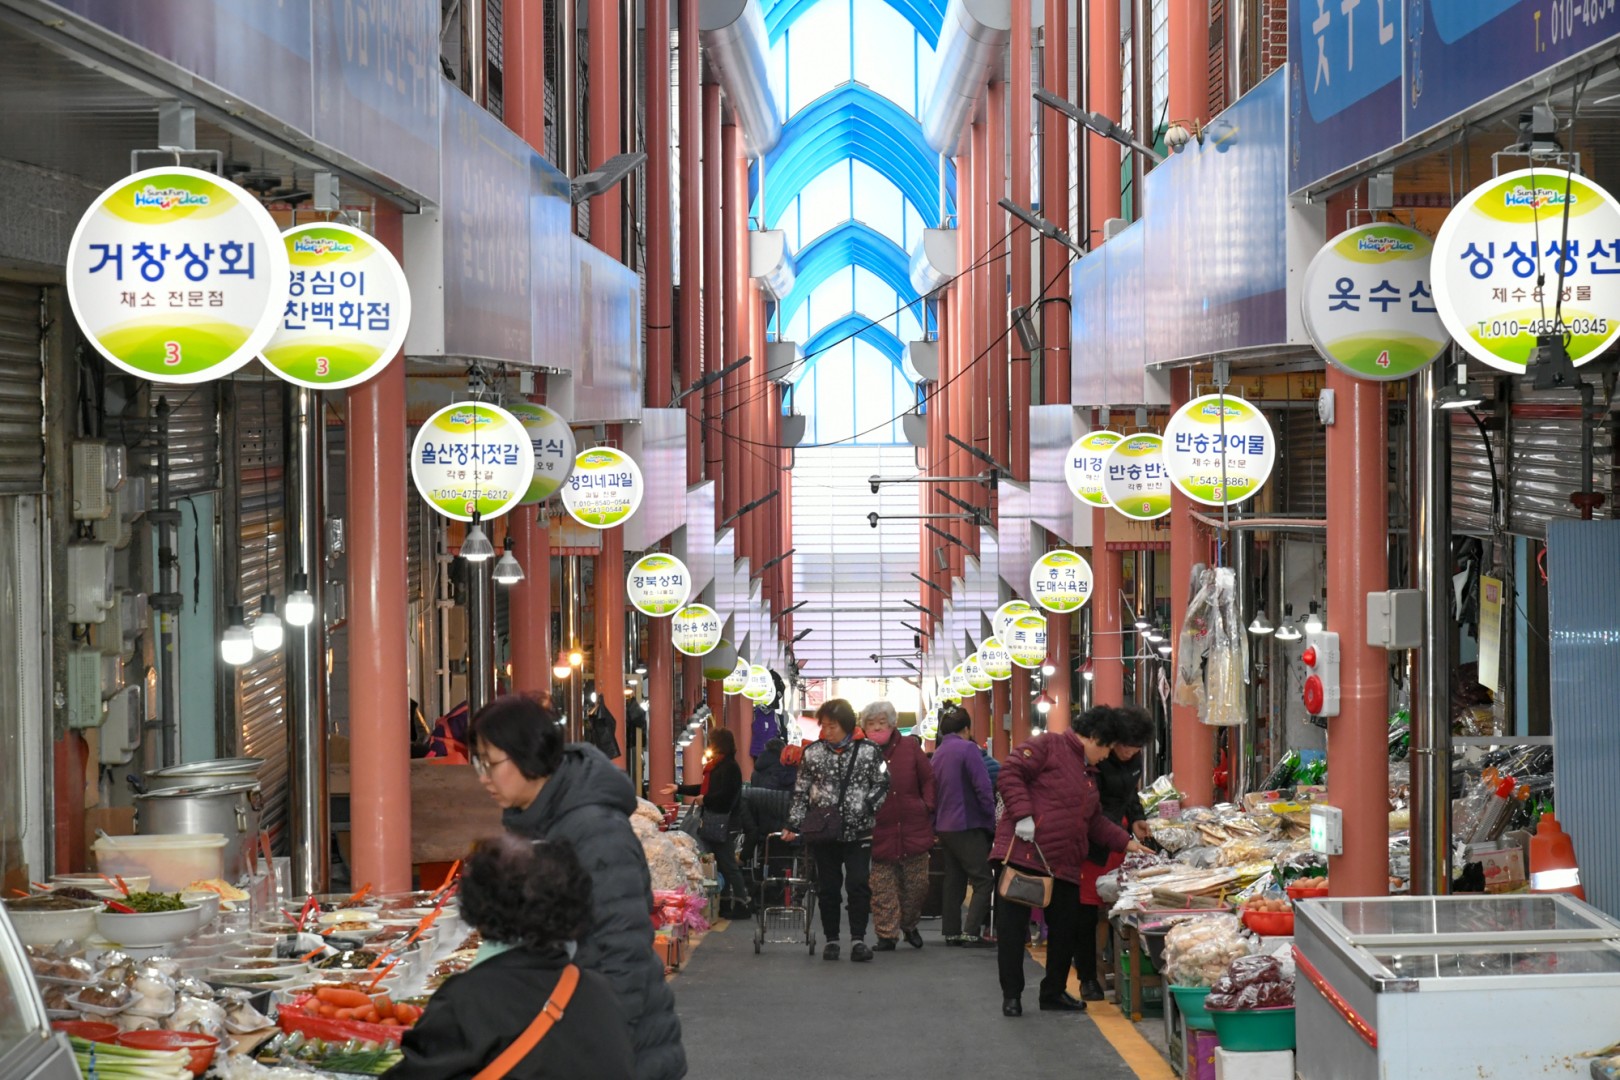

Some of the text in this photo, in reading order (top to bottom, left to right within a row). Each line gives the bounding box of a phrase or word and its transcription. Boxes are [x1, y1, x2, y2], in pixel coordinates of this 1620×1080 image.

[135, 193, 209, 208] Haeundae
[1506, 193, 1577, 208] Haeundae
[295, 241, 353, 254] Haeundae
[1359, 239, 1414, 252] Haeundae
[89, 240, 255, 282] 거창상회
[1461, 239, 1620, 279] 싱싱생선
[289, 270, 364, 297] 영심이
[120, 290, 224, 308] 채소 전문점
[165, 343, 180, 364] 3
[1376, 351, 1389, 367] 4
[316, 358, 328, 375] 3
[1176, 432, 1264, 455] 반송건어물
[422, 442, 519, 465] 울산정자젓갈
[568, 472, 633, 490] 영희네과일
[1214, 488, 1223, 499] 5
[465, 501, 475, 514] 6
[1143, 503, 1150, 511] 8
[633, 574, 682, 588] 경북상회
[1036, 580, 1088, 592] 도매식육점
